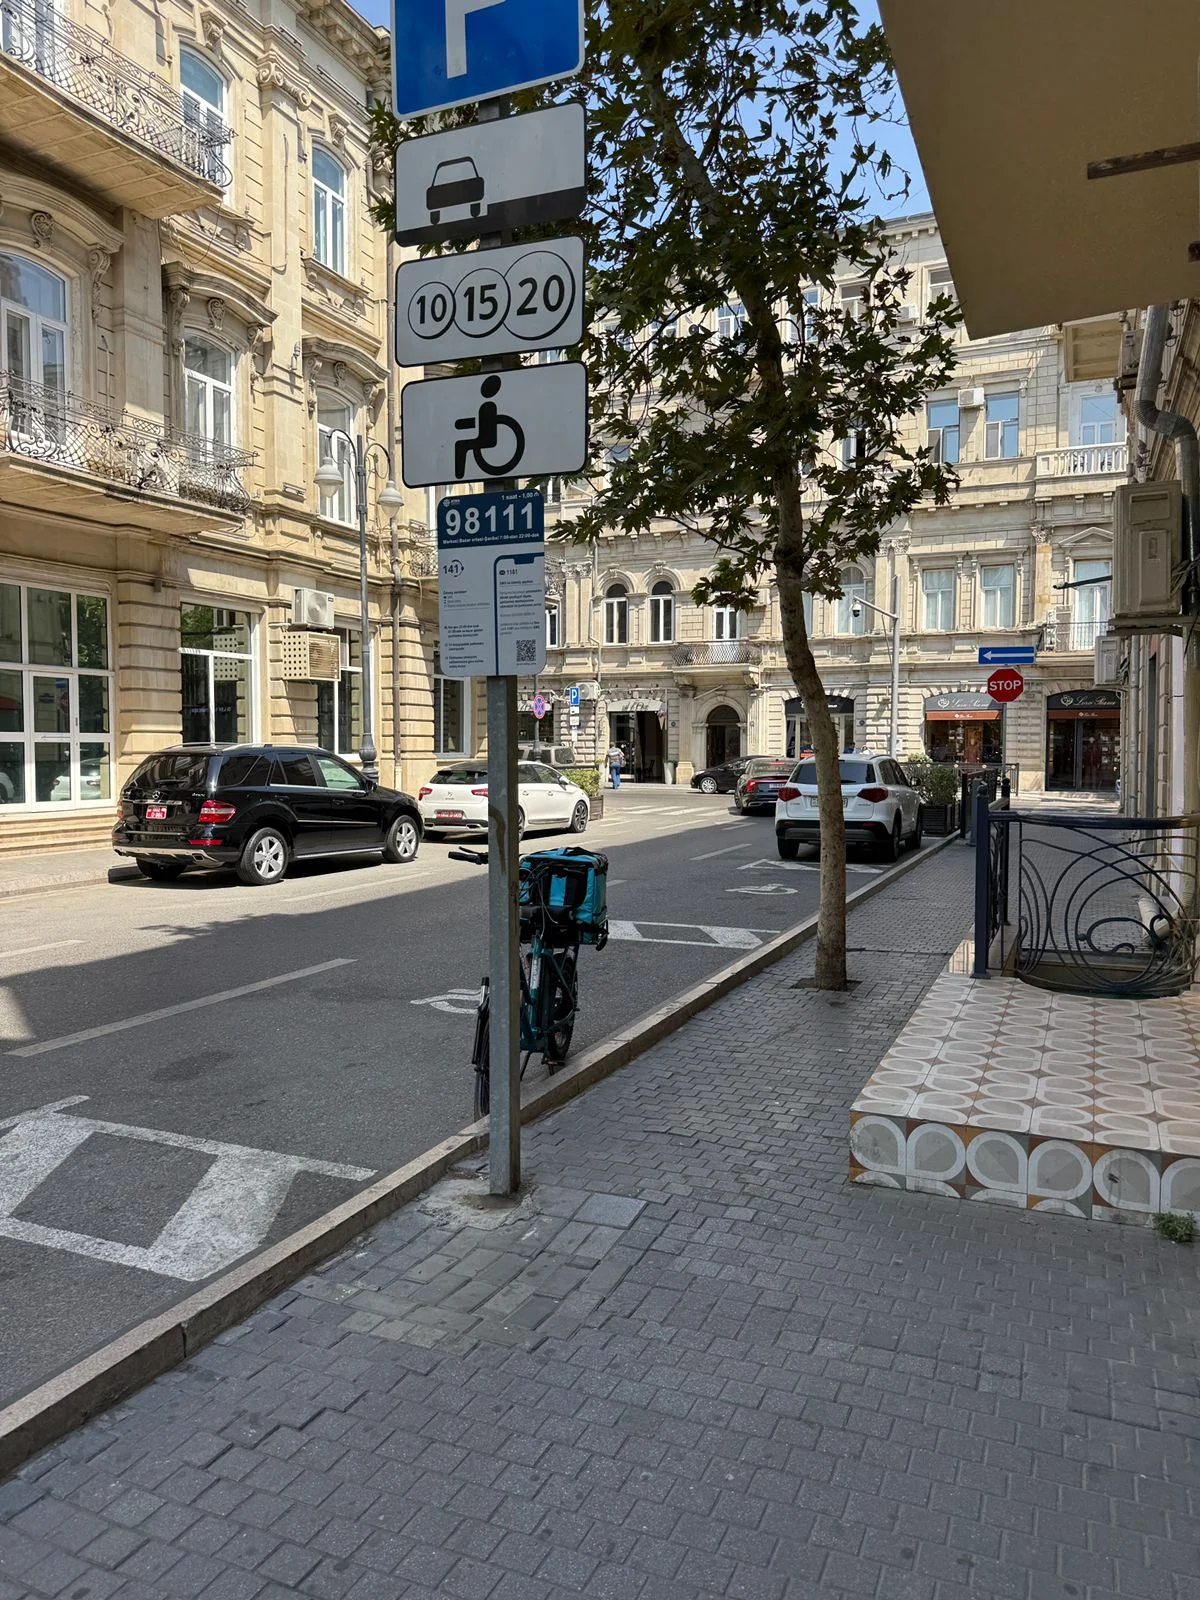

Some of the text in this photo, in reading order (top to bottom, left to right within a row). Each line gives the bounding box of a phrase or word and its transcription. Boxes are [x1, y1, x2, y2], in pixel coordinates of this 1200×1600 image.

[415, 293, 448, 325] 10
[463, 283, 499, 322] 15
[516, 274, 565, 317] 20
[445, 502, 533, 536] 98111
[443, 564, 459, 574] 141
[571, 688, 578, 704] P
[989, 680, 1022, 691] STOP
